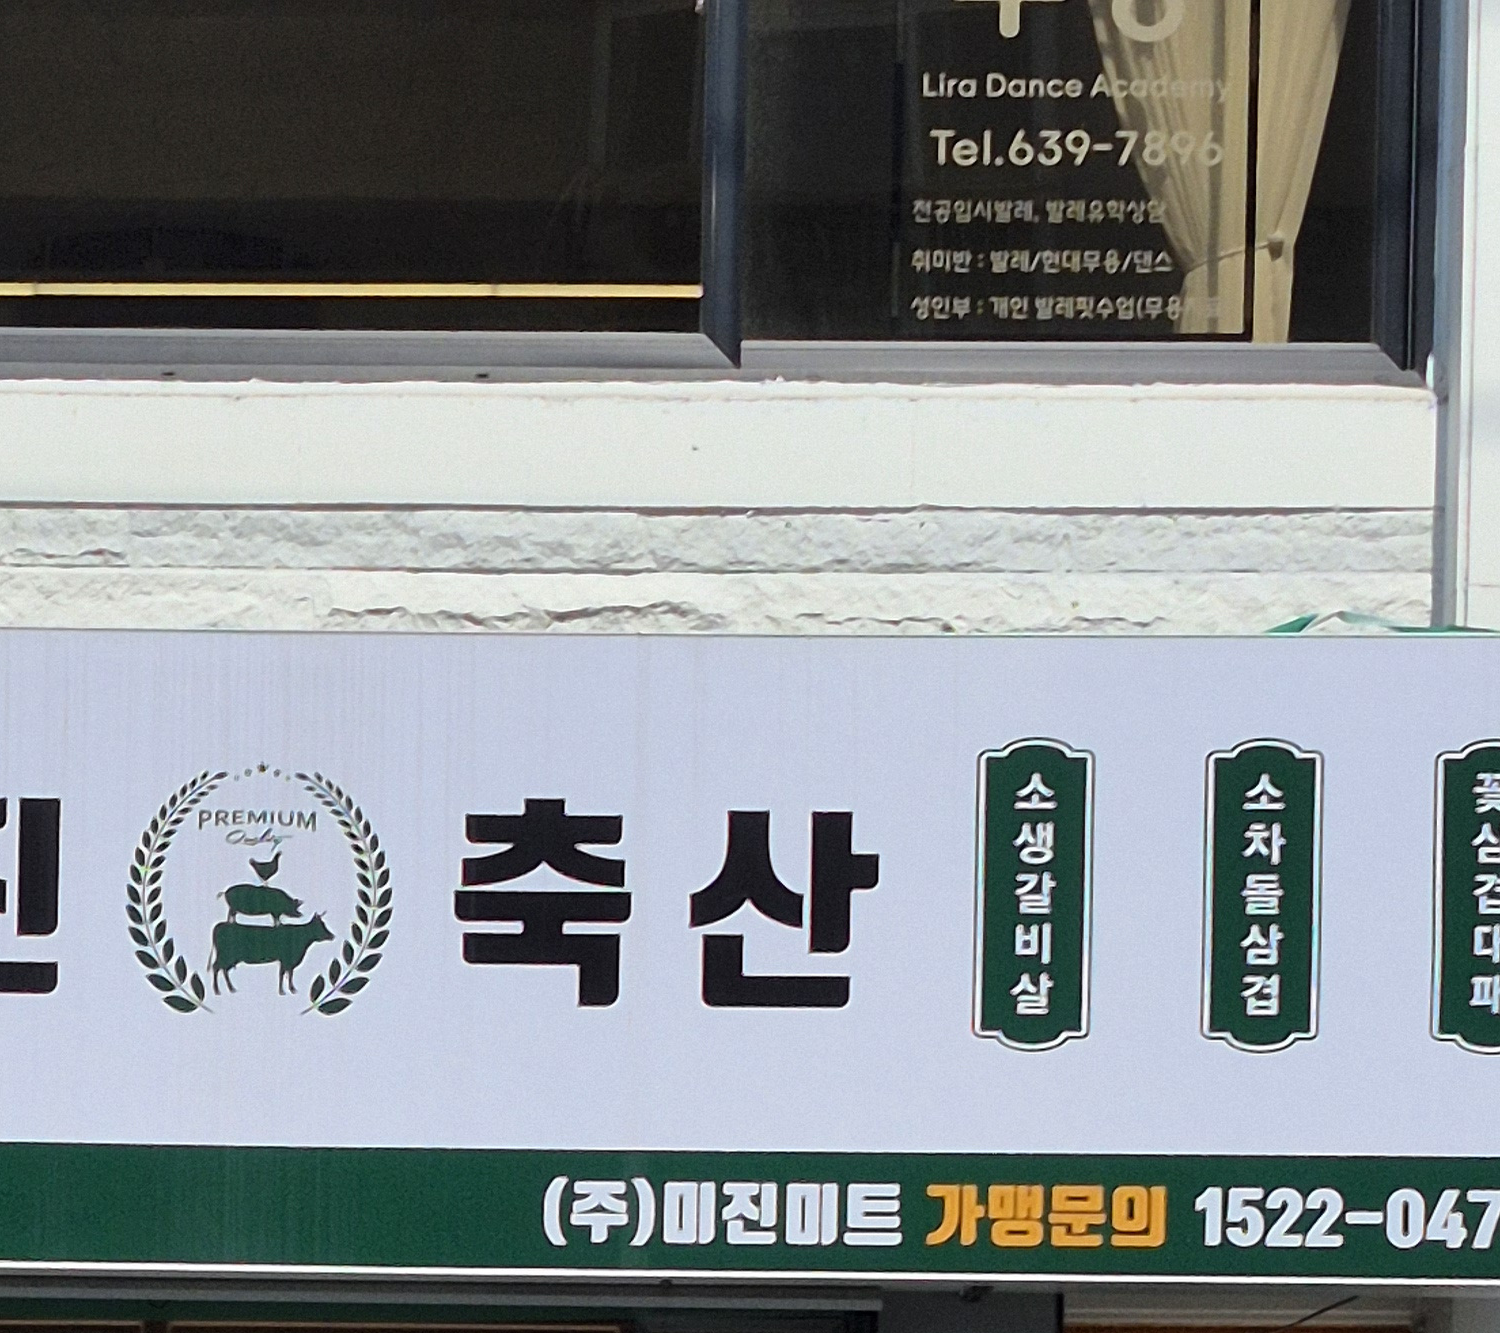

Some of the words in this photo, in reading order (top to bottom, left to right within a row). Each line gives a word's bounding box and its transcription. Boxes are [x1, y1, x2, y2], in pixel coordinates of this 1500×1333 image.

[921, 72, 977, 98] Lira
[986, 73, 1083, 98] Dance
[930, 130, 1224, 168] Tel.639-7896
[198, 809, 318, 833] PREMIUM
[453, 797, 880, 1008] 축산
[1009, 772, 1057, 1016] 소생갈비살
[1238, 772, 1286, 1017] 소차돌삼겹
[542, 1174, 903, 1248] (주)미진미트
[924, 1183, 1168, 1248] 가맹문의
[1194, 1186, 1500, 1250] 1522-047
